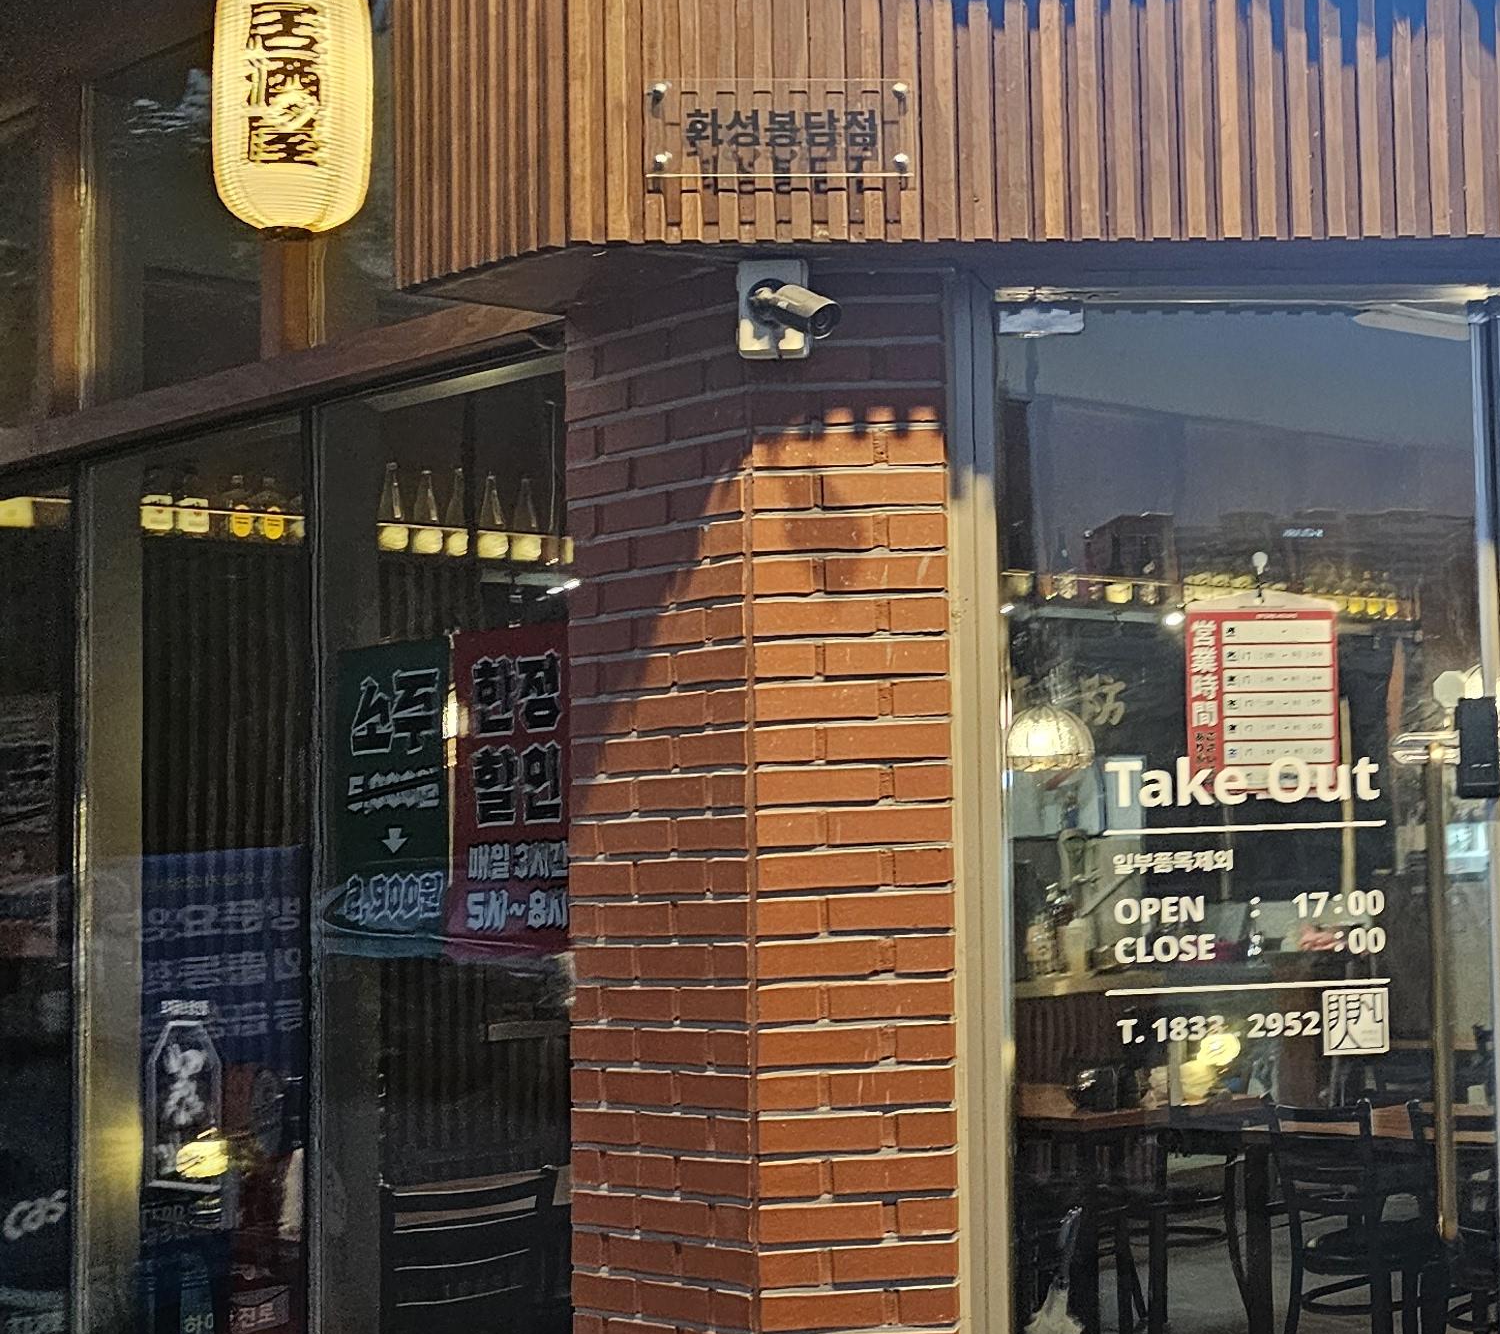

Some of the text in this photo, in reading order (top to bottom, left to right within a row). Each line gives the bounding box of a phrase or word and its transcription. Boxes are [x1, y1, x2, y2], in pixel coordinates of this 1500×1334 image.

[686, 108, 878, 148] 화성봉담점
[351, 667, 441, 756] 소주
[471, 649, 562, 738] 한정
[472, 739, 563, 828] 할인
[1104, 757, 1249, 810] Take
[1267, 755, 1381, 804] Out
[468, 843, 510, 881] 매일
[1114, 895, 1205, 925] OPEN
[1291, 889, 1385, 919] 17:00
[1114, 933, 1216, 964] CLOSE
[1116, 1018, 1145, 1045] T.
[1247, 1012, 1322, 1037] 2952
